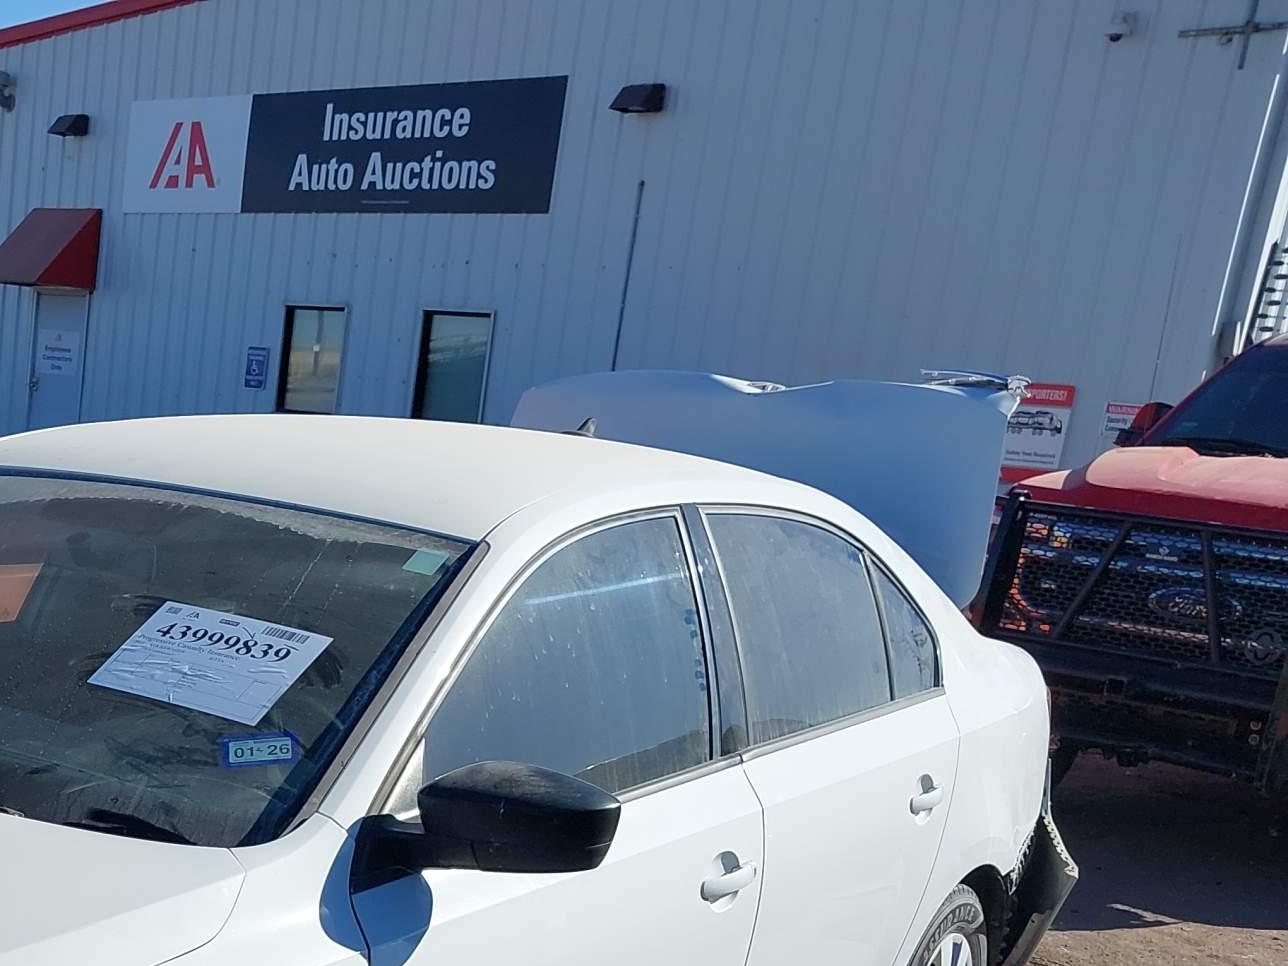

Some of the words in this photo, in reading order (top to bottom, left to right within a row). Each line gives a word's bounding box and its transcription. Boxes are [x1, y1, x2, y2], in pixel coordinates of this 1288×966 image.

[323, 103, 471, 142] Insurance
[288, 153, 354, 192] Auto
[360, 150, 496, 191] Auctions
[1027, 388, 1068, 401] PORTERS!
[156, 622, 292, 663] 43999839
